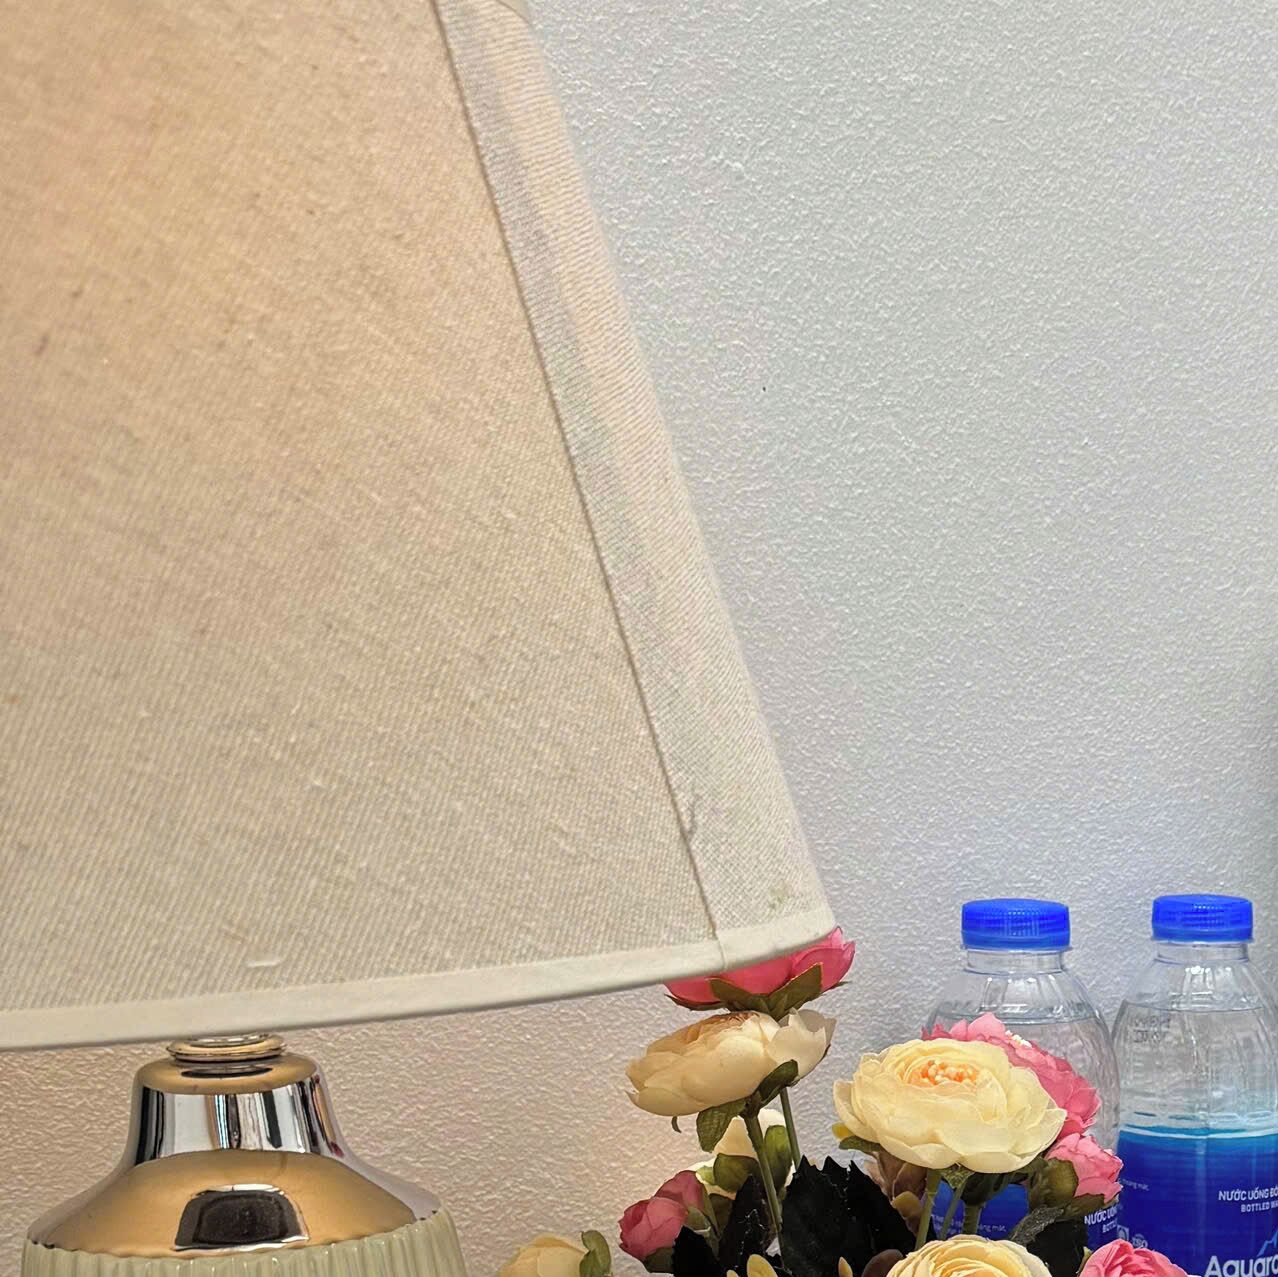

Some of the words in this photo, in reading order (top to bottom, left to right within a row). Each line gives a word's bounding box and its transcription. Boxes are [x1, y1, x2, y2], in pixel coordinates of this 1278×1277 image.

[1218, 1187, 1247, 1201] NƯỚC
[1247, 1186, 1270, 1200] UỐNG
[1240, 1201, 1270, 1213] BOTTLED
